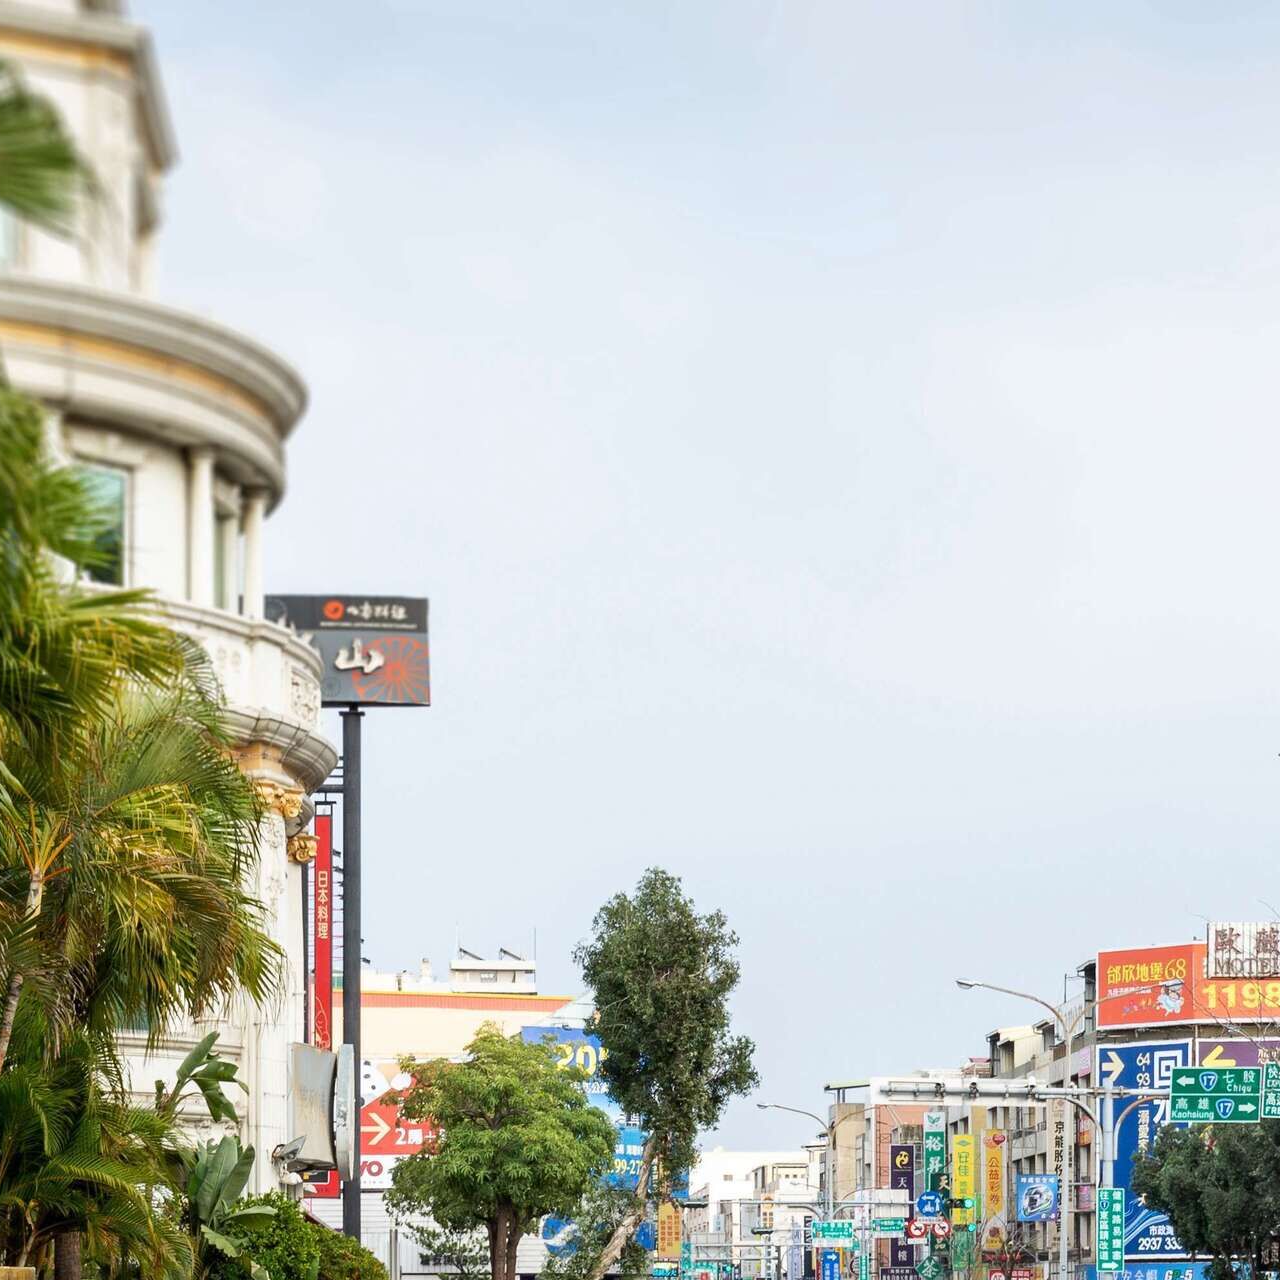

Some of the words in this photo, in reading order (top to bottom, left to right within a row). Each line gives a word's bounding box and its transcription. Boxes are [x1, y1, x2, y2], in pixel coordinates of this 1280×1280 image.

[334, 637, 385, 674] 山
[317, 870, 329, 940] 日本料理
[1203, 1077, 1215, 1086] 17
[1223, 1070, 1255, 1083] 七股
[1175, 1097, 1210, 1110] 高雄
[1219, 1104, 1231, 1113] 17
[1172, 1109, 1214, 1120] Kaohsiung
[1138, 1237, 1162, 1250] 2937
[922, 1260, 940, 1280] 茶
